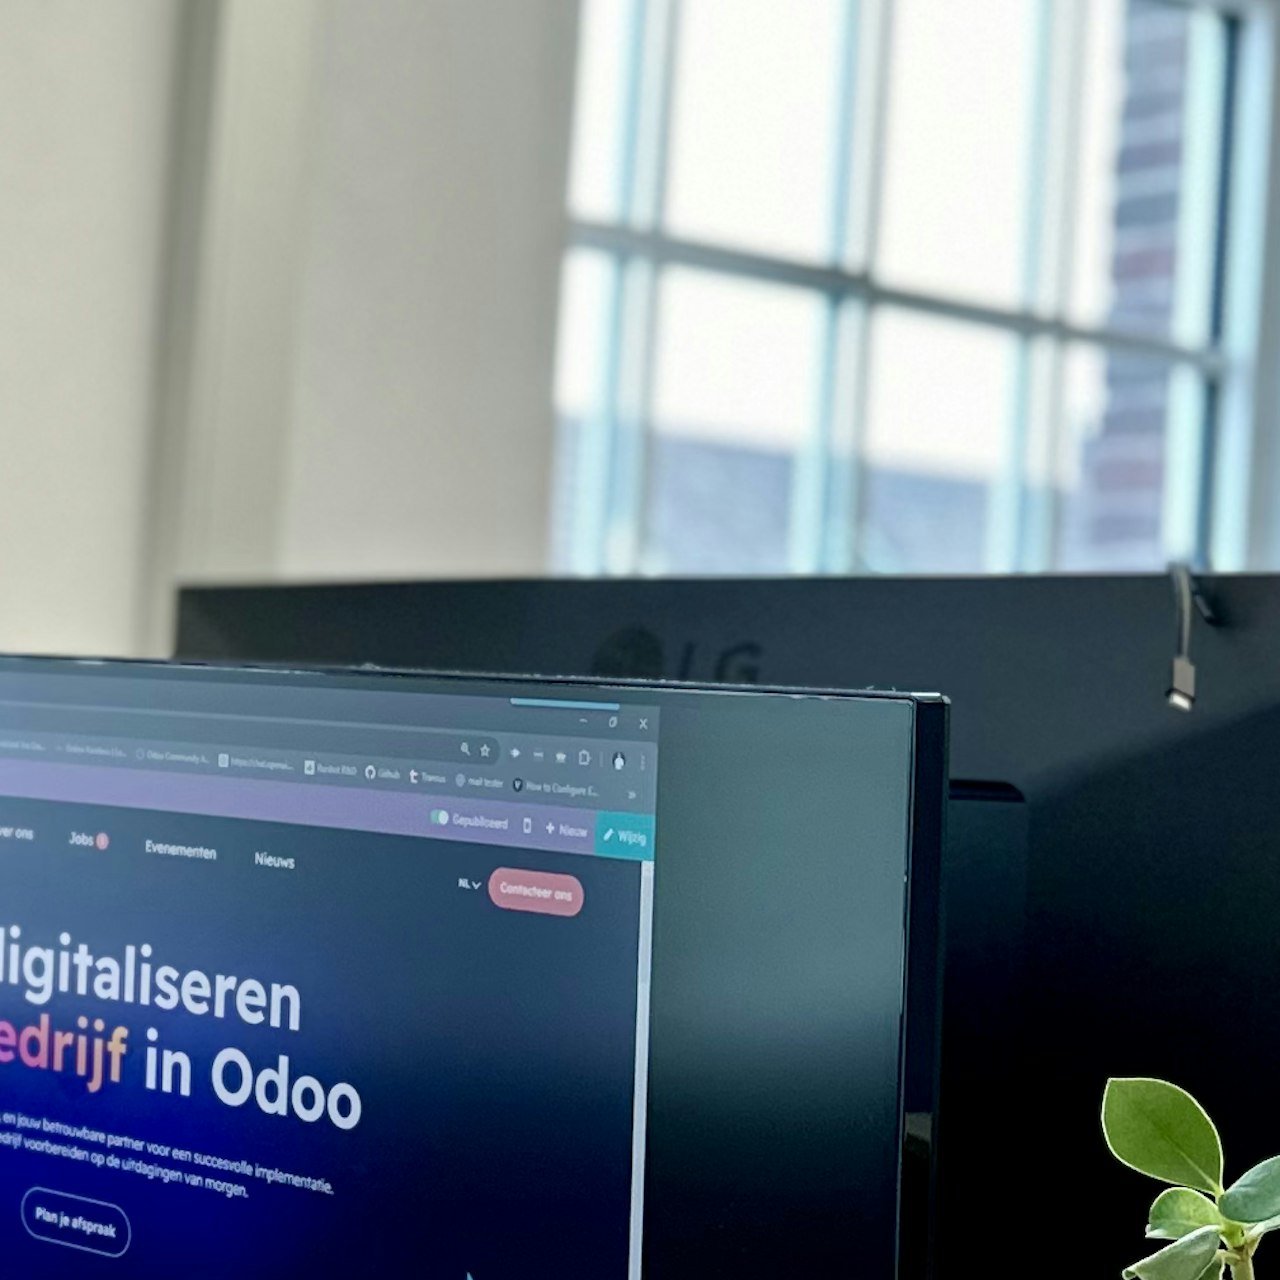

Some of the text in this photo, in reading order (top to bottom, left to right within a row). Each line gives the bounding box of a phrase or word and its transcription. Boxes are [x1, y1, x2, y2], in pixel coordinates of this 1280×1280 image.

[15, 828, 33, 840] ons
[69, 831, 94, 846] Jobs
[618, 830, 646, 847] Wijzig
[145, 840, 217, 860] Evenementen
[254, 852, 295, 869] Nieuws
[458, 878, 471, 889] NL
[500, 882, 572, 902] Contacteer ons
[145, 1028, 191, 1097] in
[211, 1048, 362, 1130] Odoo
[3, 1111, 16, 1124] en
[17, 1113, 41, 1131] jouw
[42, 1117, 105, 1144] betrouwbare
[107, 1133, 145, 1152] partner
[146, 1142, 171, 1157] voor
[172, 1148, 191, 1161] een
[193, 1154, 253, 1177] succesvolle
[255, 1164, 334, 1195] implementatie.
[24, 1136, 89, 1163] voorbereiden
[90, 1152, 105, 1168] op
[106, 1153, 121, 1169] de
[122, 1158, 183, 1184] uitdagingen
[184, 1172, 204, 1187] van
[205, 1177, 249, 1199] morgen.
[35, 1206, 116, 1238] Plan je afspraak
